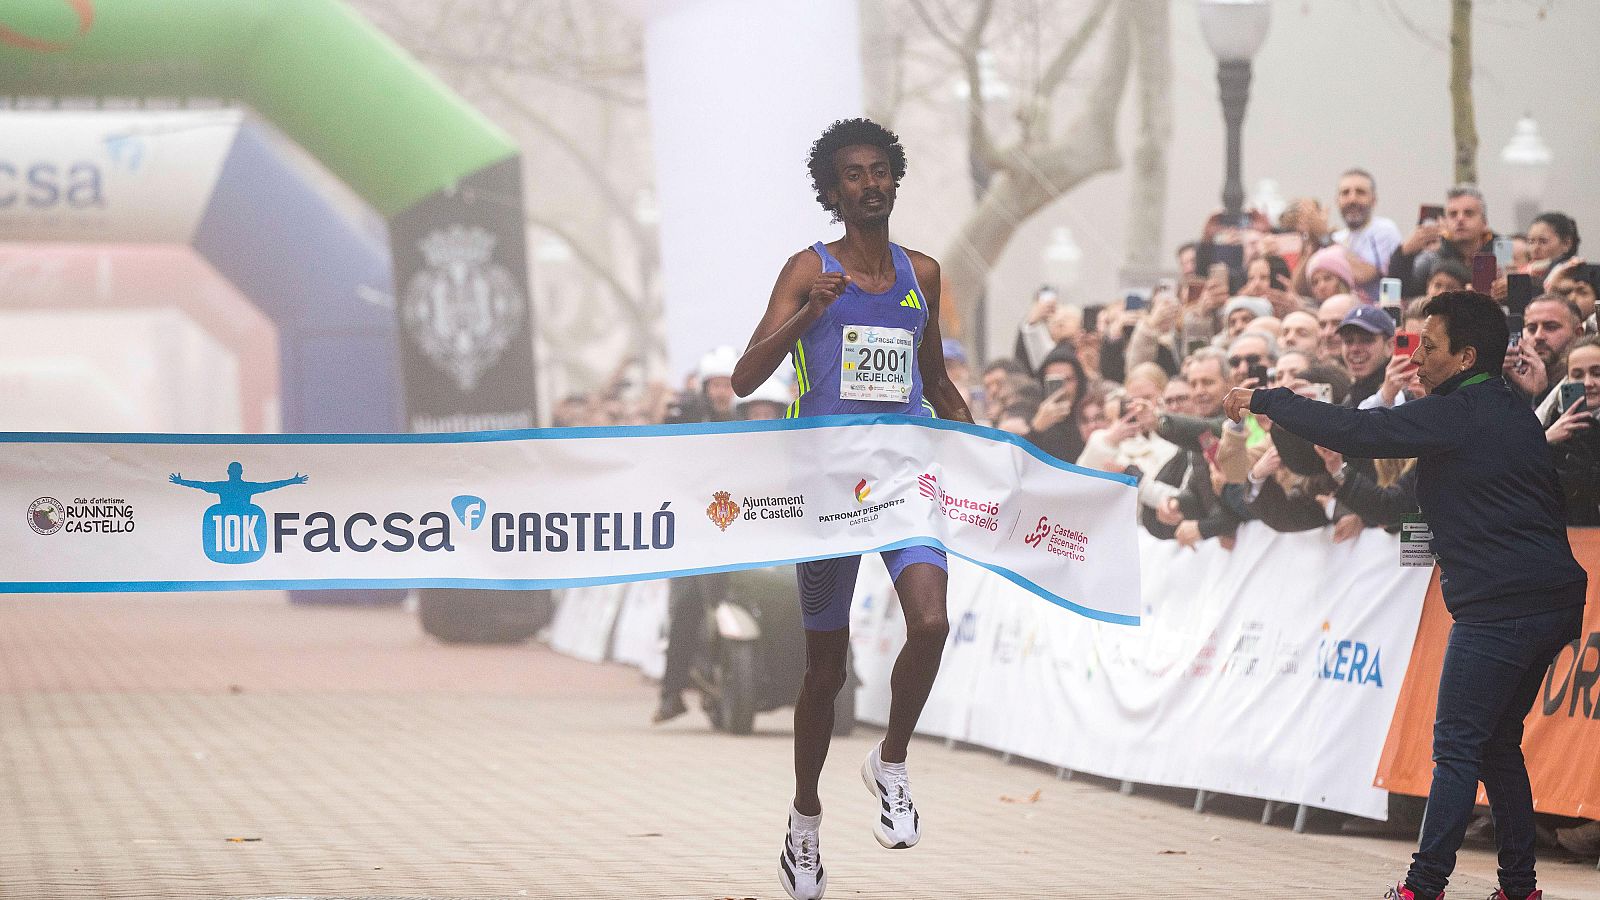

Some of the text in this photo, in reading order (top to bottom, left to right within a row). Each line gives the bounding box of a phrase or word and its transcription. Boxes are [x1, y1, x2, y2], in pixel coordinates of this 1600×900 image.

[858, 347, 906, 373] 2001
[855, 372, 904, 383] KEJELCHA
[742, 494, 805, 510] Ajuntament
[818, 498, 905, 523] PATRONAT D'ESPORTS
[66, 506, 134, 518] RUNNING
[743, 503, 804, 521] de Castelló
[849, 514, 879, 526] CASTELLÓ
[938, 501, 998, 532] e Castelló
[65, 516, 135, 533] CASTELLÓ
[212, 514, 260, 553] 10K
[491, 501, 676, 552] CASTELLÓ
[1050, 534, 1085, 553] Escenario
[1053, 524, 1089, 545] Castellón
[1047, 543, 1085, 562] Deportivo
[1543, 632, 1600, 720] OR
